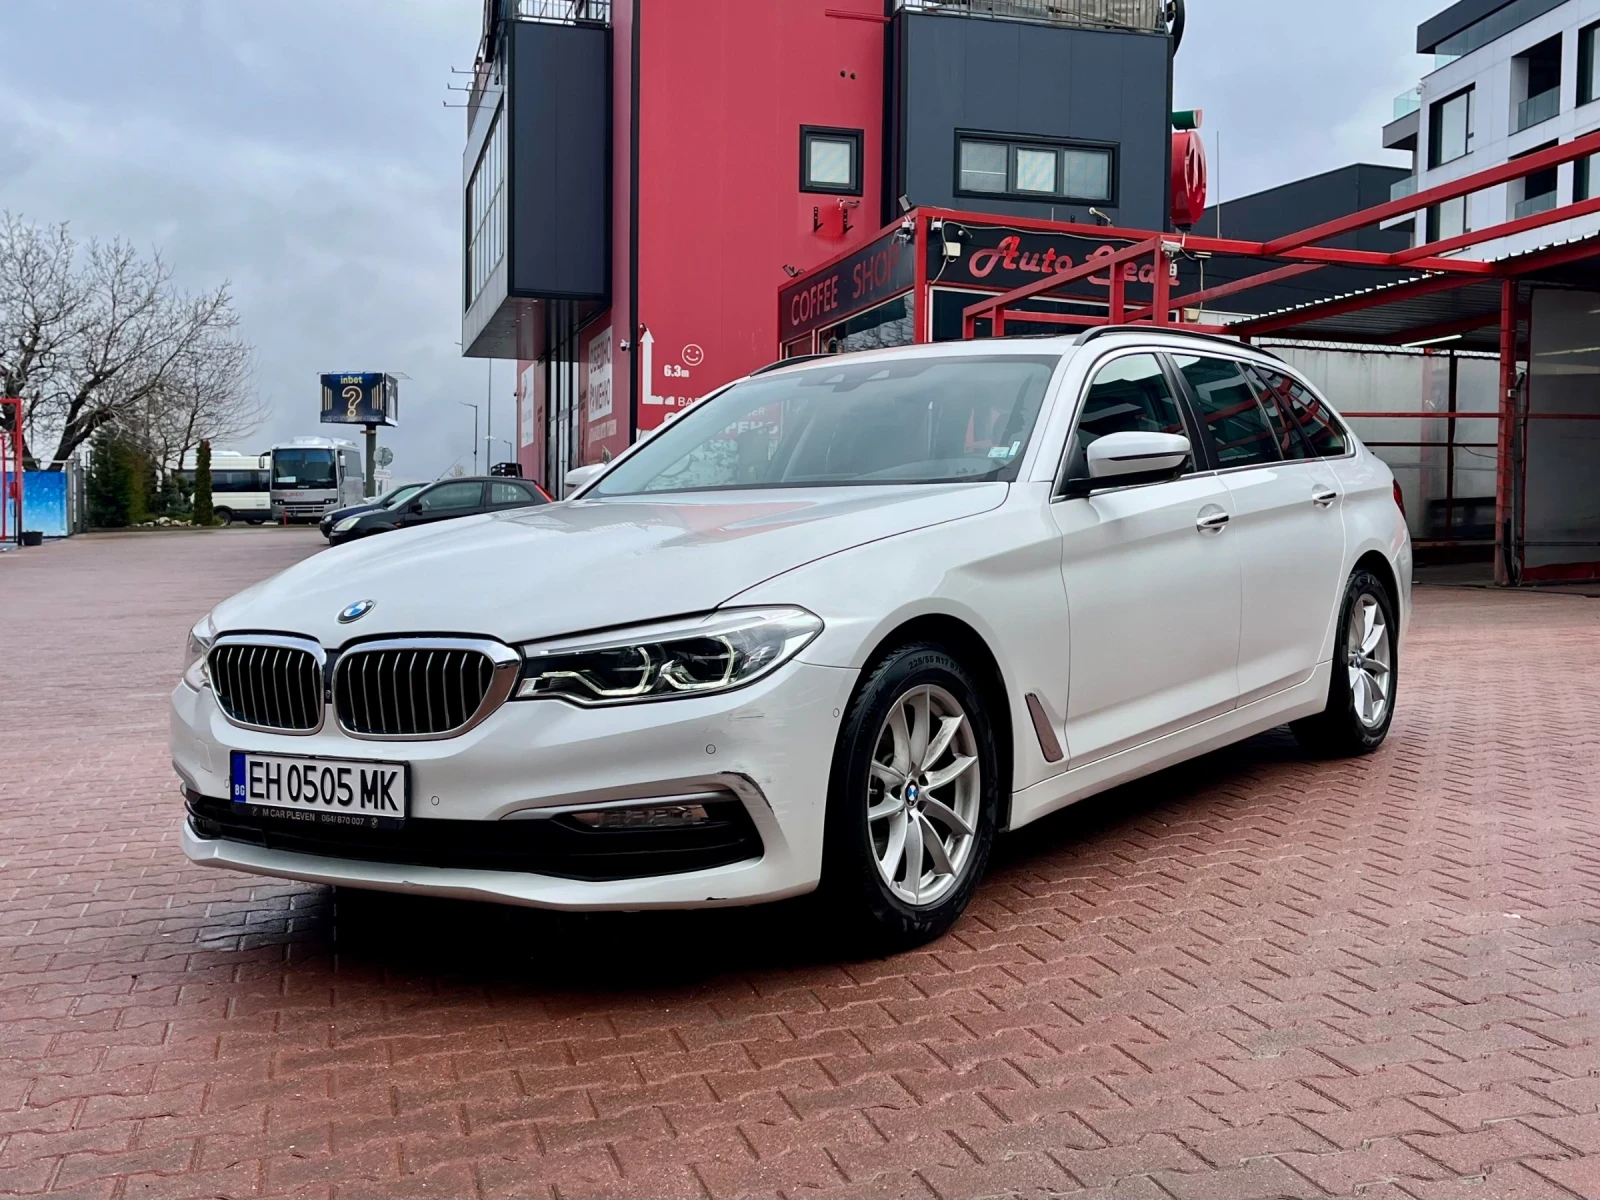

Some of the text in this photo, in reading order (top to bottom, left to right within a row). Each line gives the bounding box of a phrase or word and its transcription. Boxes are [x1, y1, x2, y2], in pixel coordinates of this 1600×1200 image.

[968, 236, 1073, 278] Auto
[791, 243, 900, 326] COFFEE SHOP
[664, 364, 690, 378] 6.3m
[908, 655, 934, 670] 225/55
[234, 784, 245, 796] BG
[249, 760, 399, 812] EH 0505 MK
[262, 808, 269, 817] M
[270, 810, 286, 819] CAR
[286, 811, 315, 822] PLEVEN
[351, 817, 365, 826] 007
